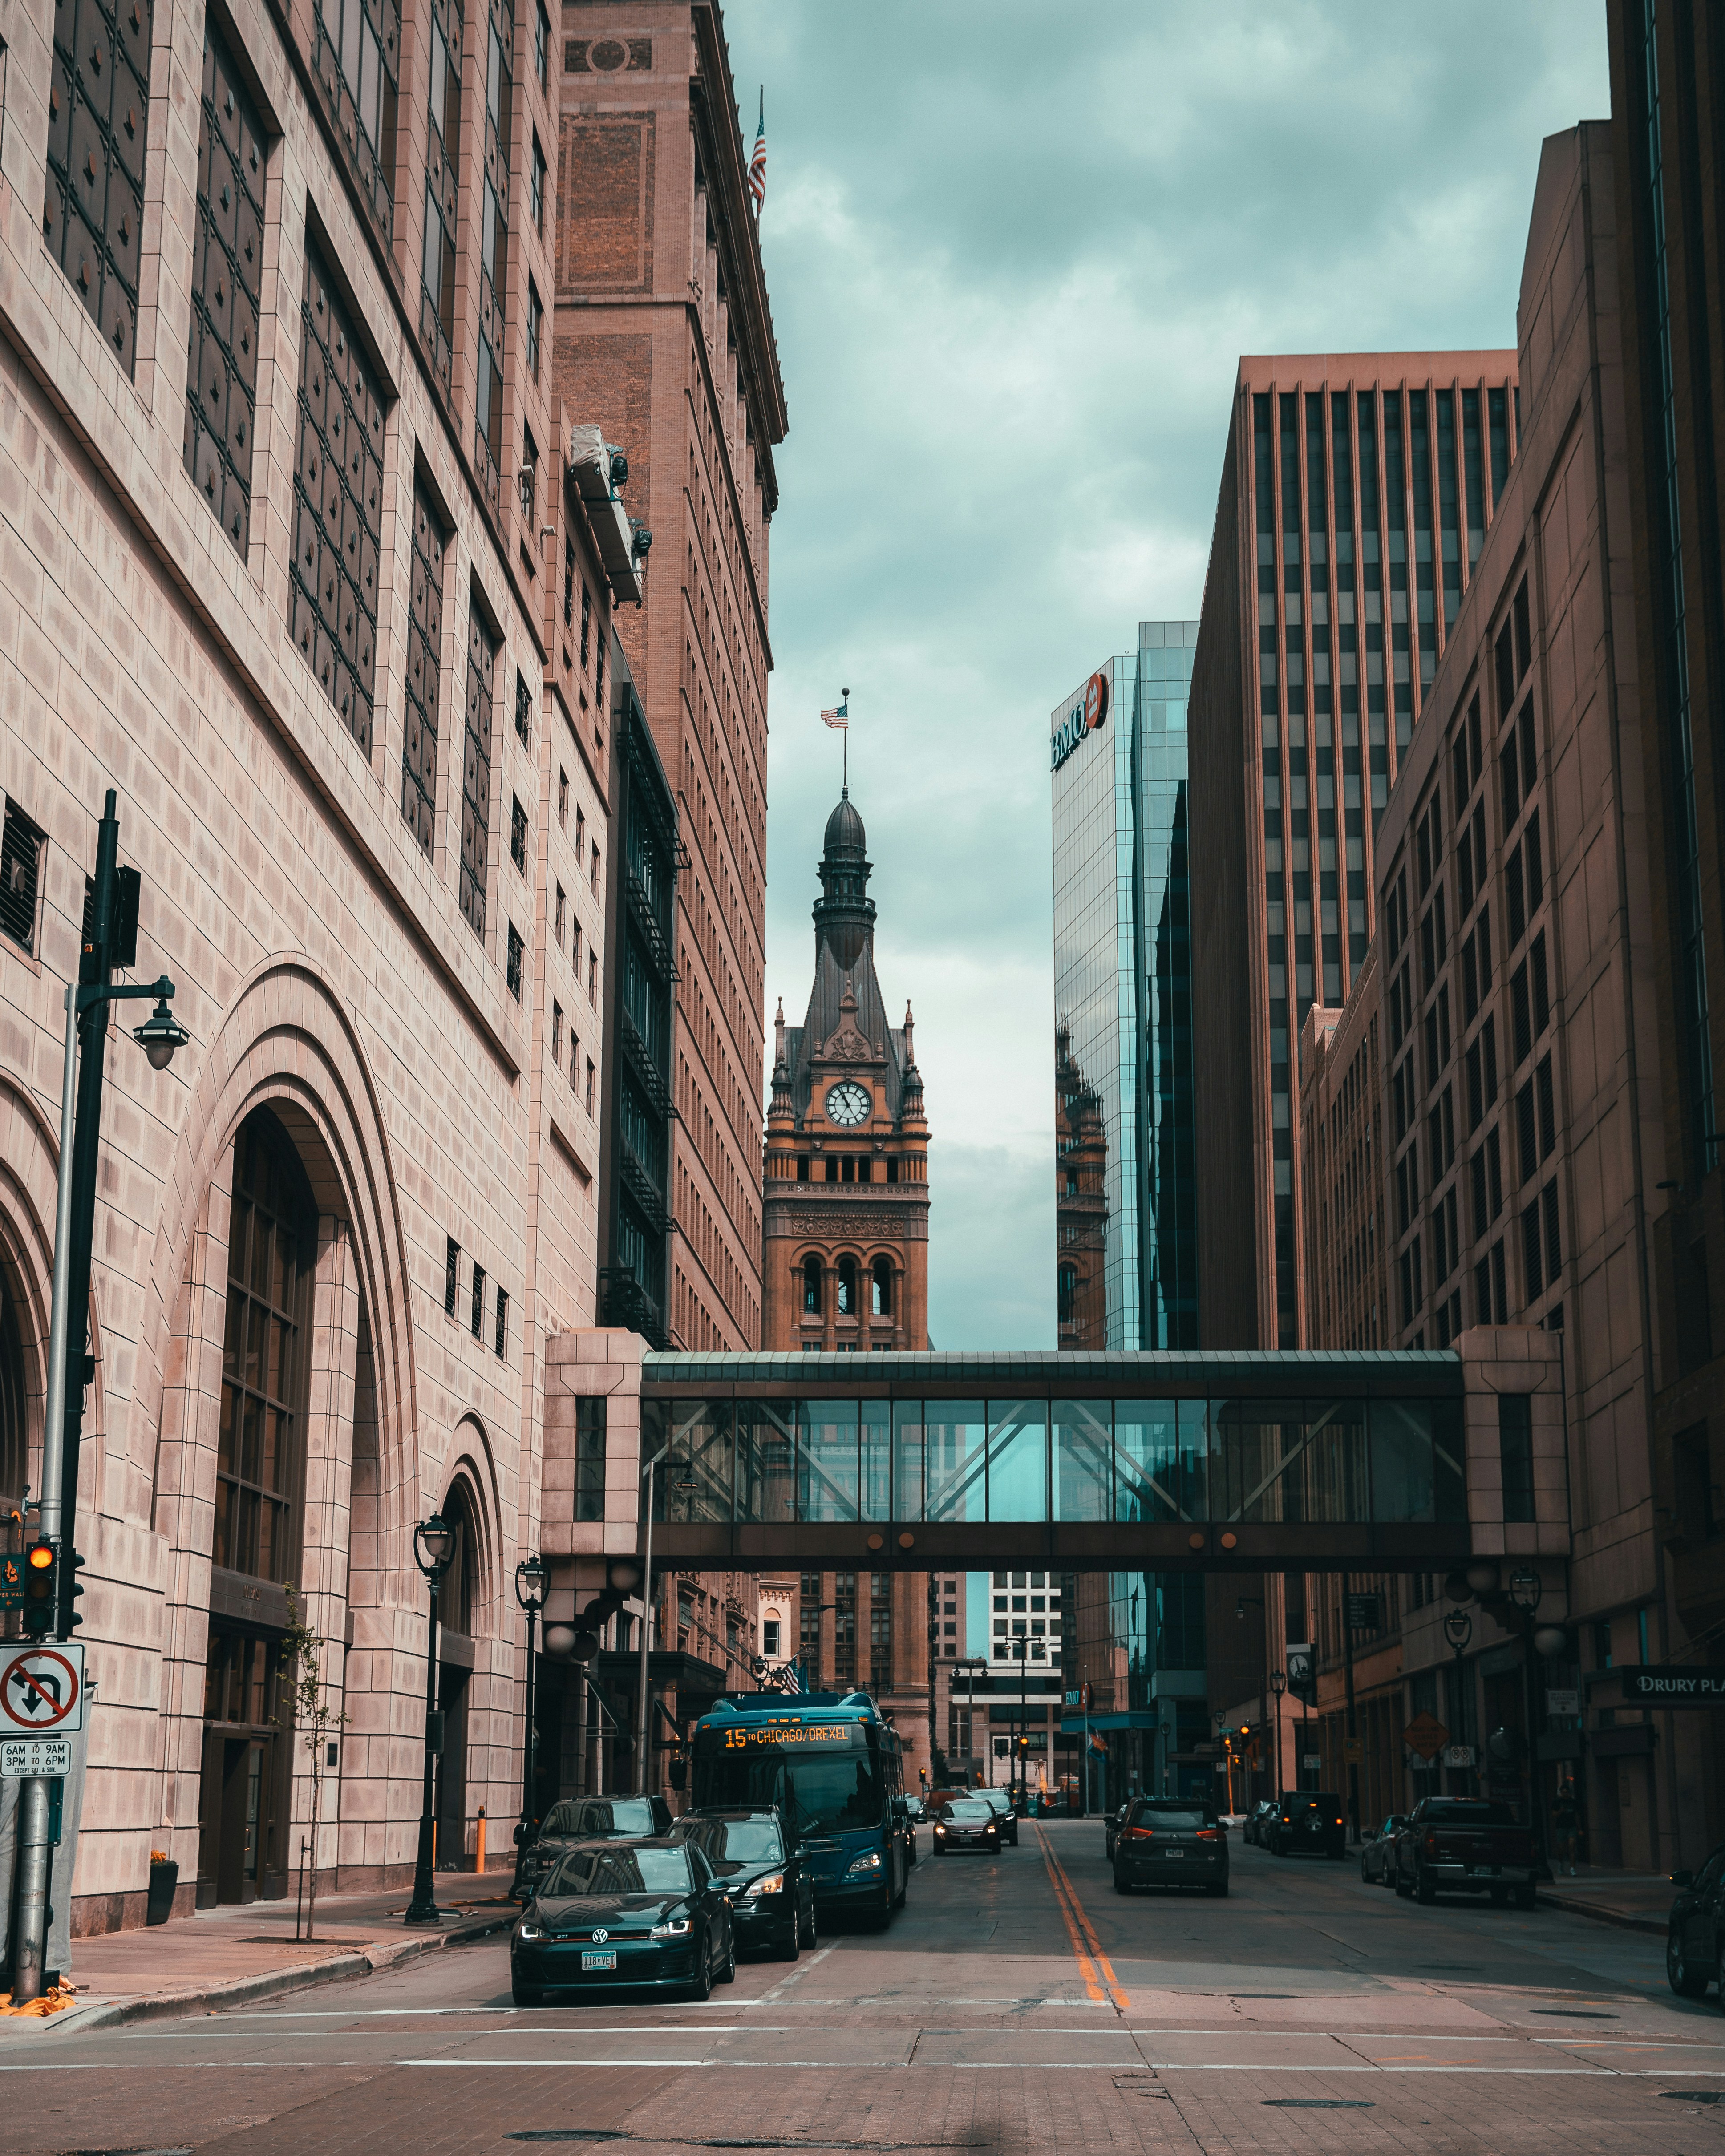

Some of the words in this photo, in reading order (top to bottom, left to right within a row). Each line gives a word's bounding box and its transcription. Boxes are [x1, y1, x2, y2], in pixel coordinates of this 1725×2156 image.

[1050, 700, 1086, 773] BMO
[1636, 1676, 1696, 1691] DRURY
[1066, 1691, 1079, 1705] BMO
[725, 1729, 746, 1747] 15
[757, 1727, 848, 1743] CHICAGO/DREXEL
[6, 1745, 26, 1755] 6AM
[46, 1744, 65, 1753] 9AM
[6, 1757, 26, 1766] 3PM
[45, 1756, 65, 1765] 6PM
[584, 1956, 597, 1966] 118
[602, 1956, 614, 1965] VET
